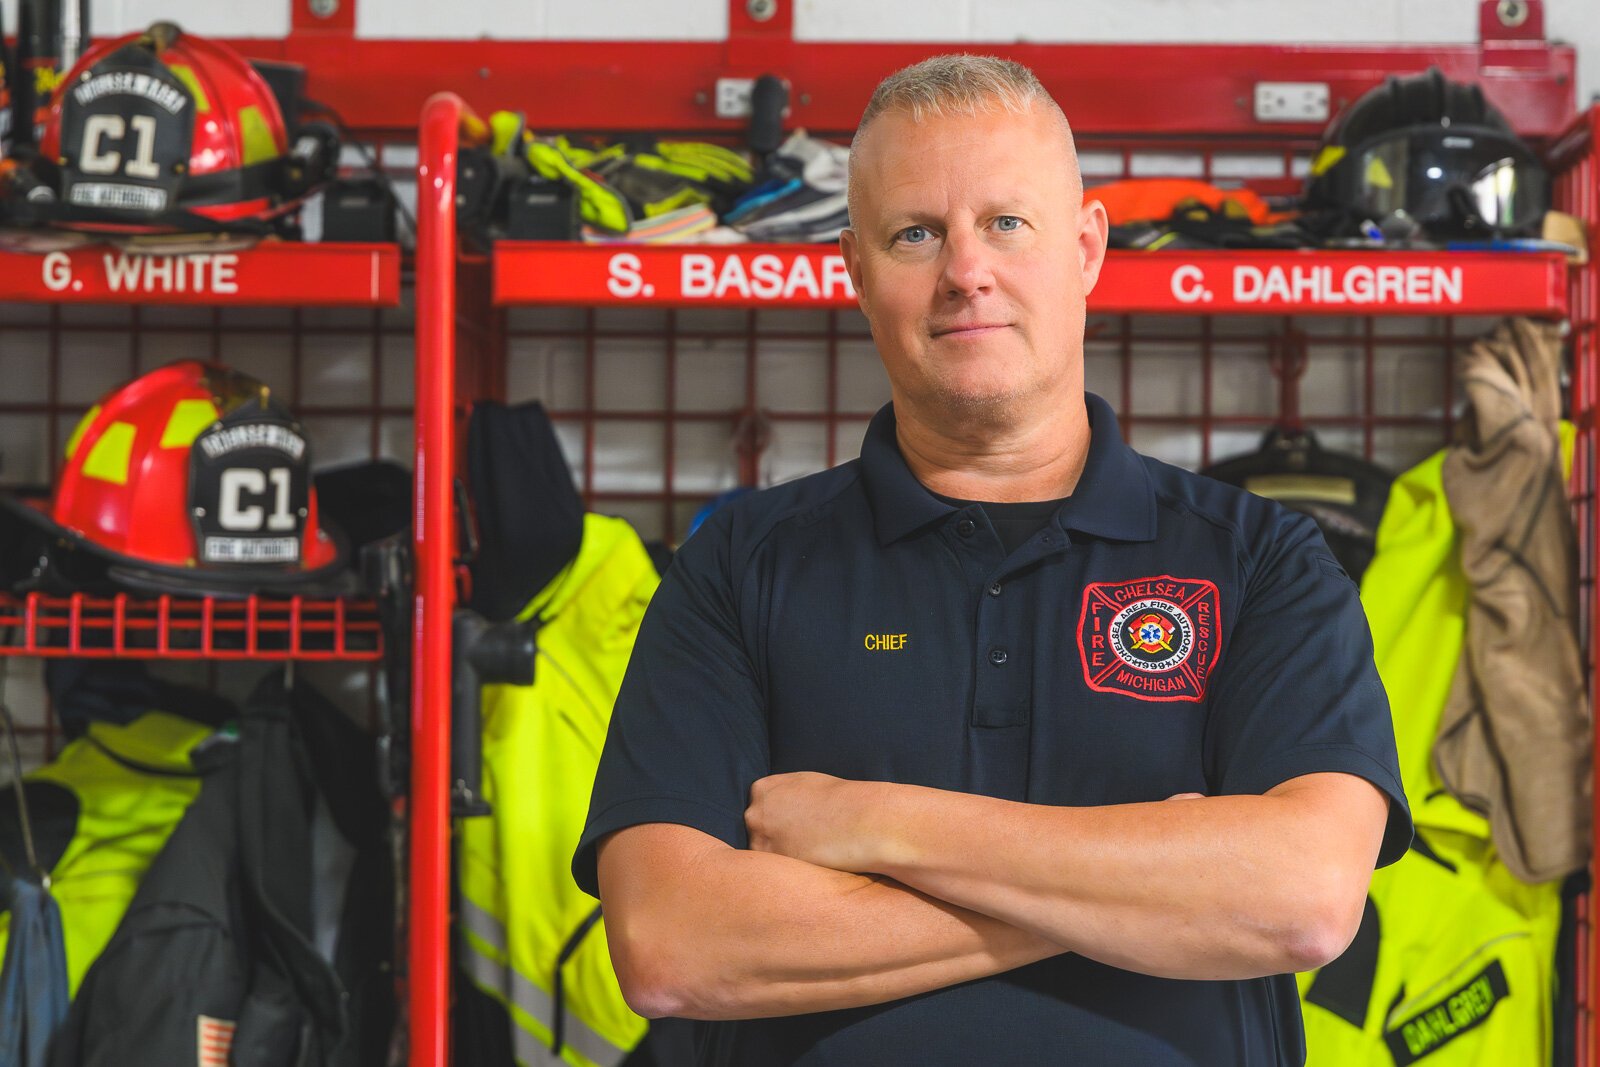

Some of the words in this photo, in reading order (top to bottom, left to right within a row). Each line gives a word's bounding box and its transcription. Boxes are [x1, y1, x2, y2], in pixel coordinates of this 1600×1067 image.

[79, 114, 160, 179] C1
[42, 252, 83, 291] G.
[103, 253, 239, 293] WHITE
[607, 253, 655, 298] S.
[1170, 265, 1213, 303] C.
[1233, 265, 1463, 304] DAHLGREN
[218, 467, 297, 531] C1
[1114, 582, 1186, 602] CHELSEA
[1120, 602, 1147, 620] AREA
[1150, 601, 1175, 612] FIRE
[864, 633, 908, 651] CHIEF
[1091, 601, 1105, 667] FIRE
[1111, 621, 1132, 662] CHELSEA
[1173, 612, 1192, 666] AUTHORITY
[1196, 601, 1210, 680] RESCUE
[1115, 669, 1187, 692] MICHIGAN
